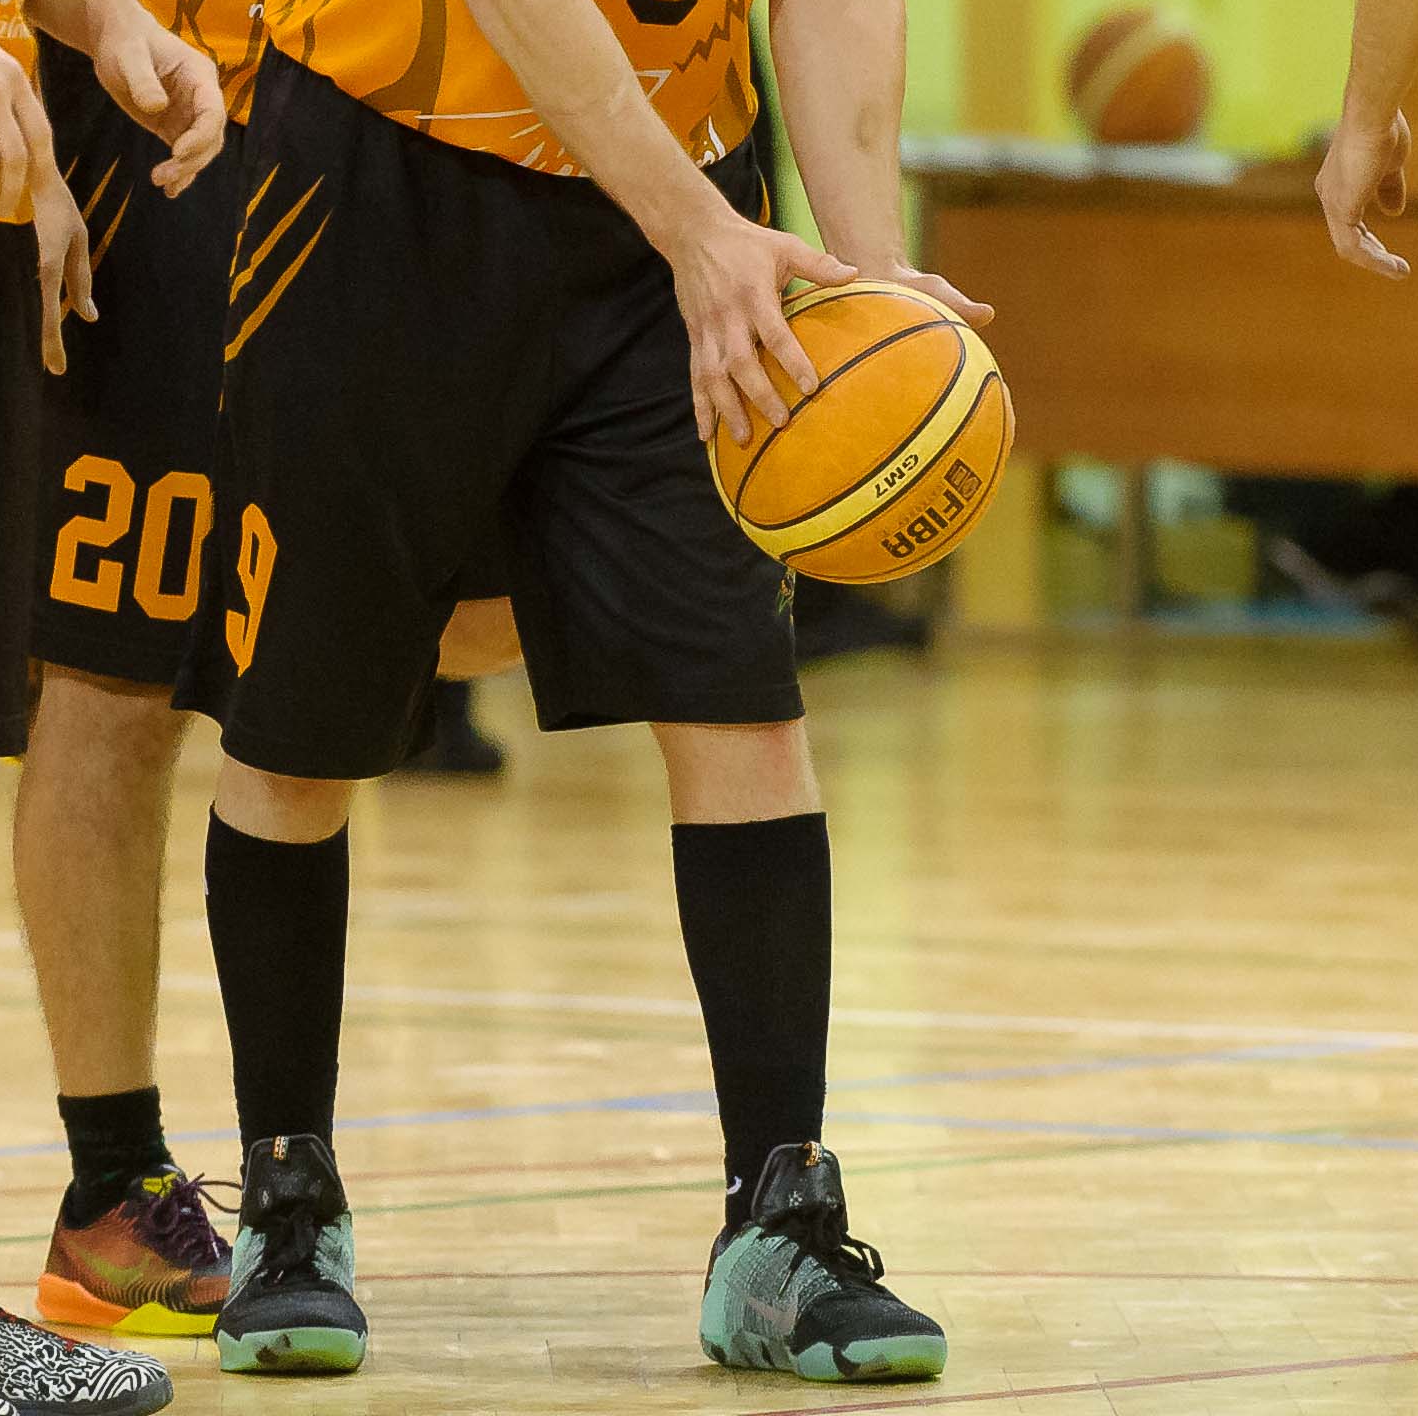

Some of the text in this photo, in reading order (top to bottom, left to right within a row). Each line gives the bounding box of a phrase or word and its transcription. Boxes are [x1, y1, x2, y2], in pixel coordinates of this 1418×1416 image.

[874, 454, 919, 498] GM7
[881, 489, 965, 558] FIBA
[49, 454, 215, 621] 20
[225, 502, 278, 677] 9
